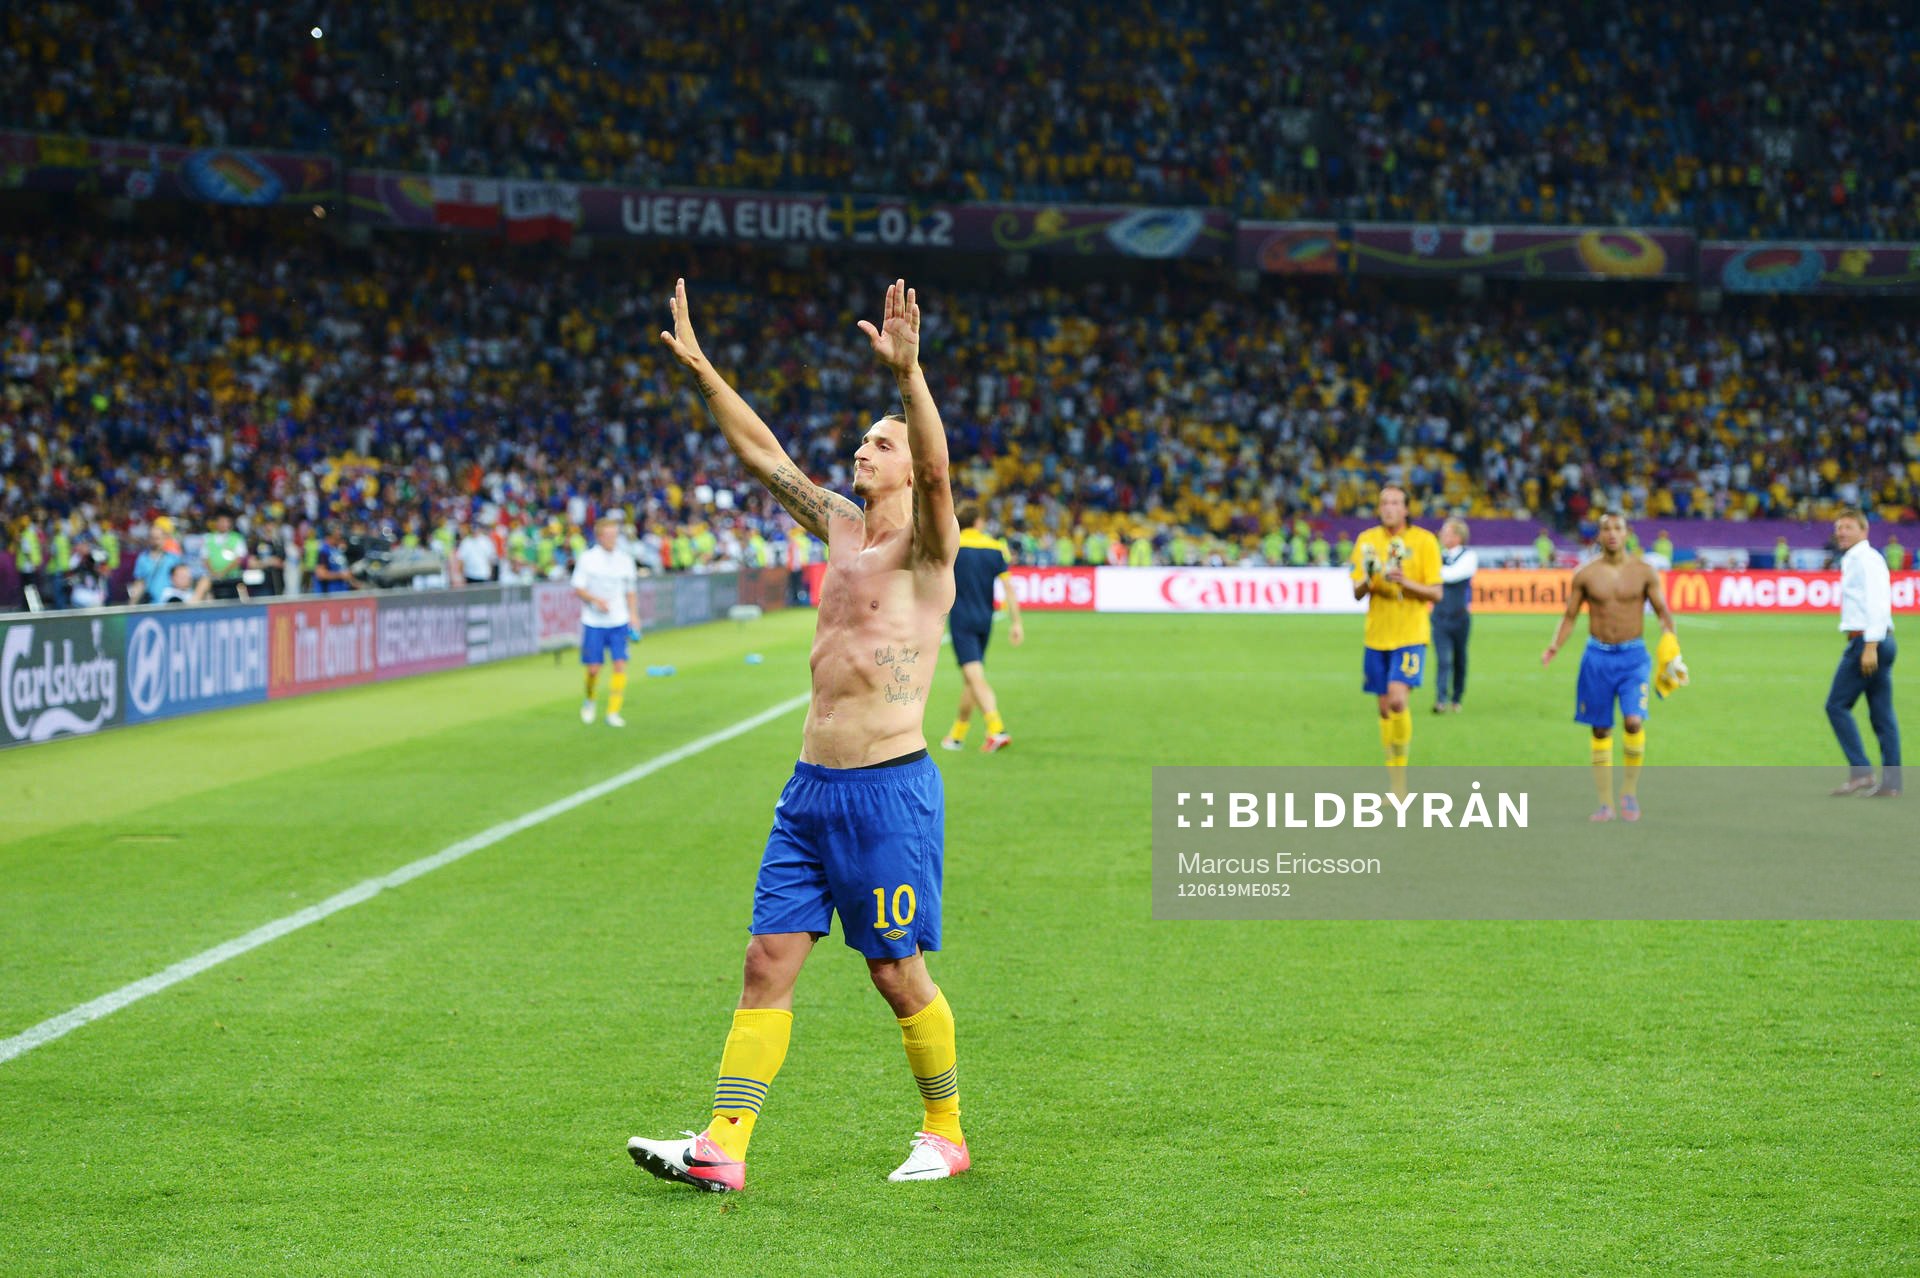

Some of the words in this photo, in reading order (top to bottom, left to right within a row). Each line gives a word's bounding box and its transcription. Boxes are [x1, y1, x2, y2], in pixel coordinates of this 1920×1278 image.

[621, 195, 727, 236] UEFA
[852, 208, 953, 245] 02
[1160, 571, 1320, 609] Canon
[0, 620, 118, 740] Carlsberg
[169, 614, 268, 702] HYUNDAI
[872, 884, 916, 929] 10
